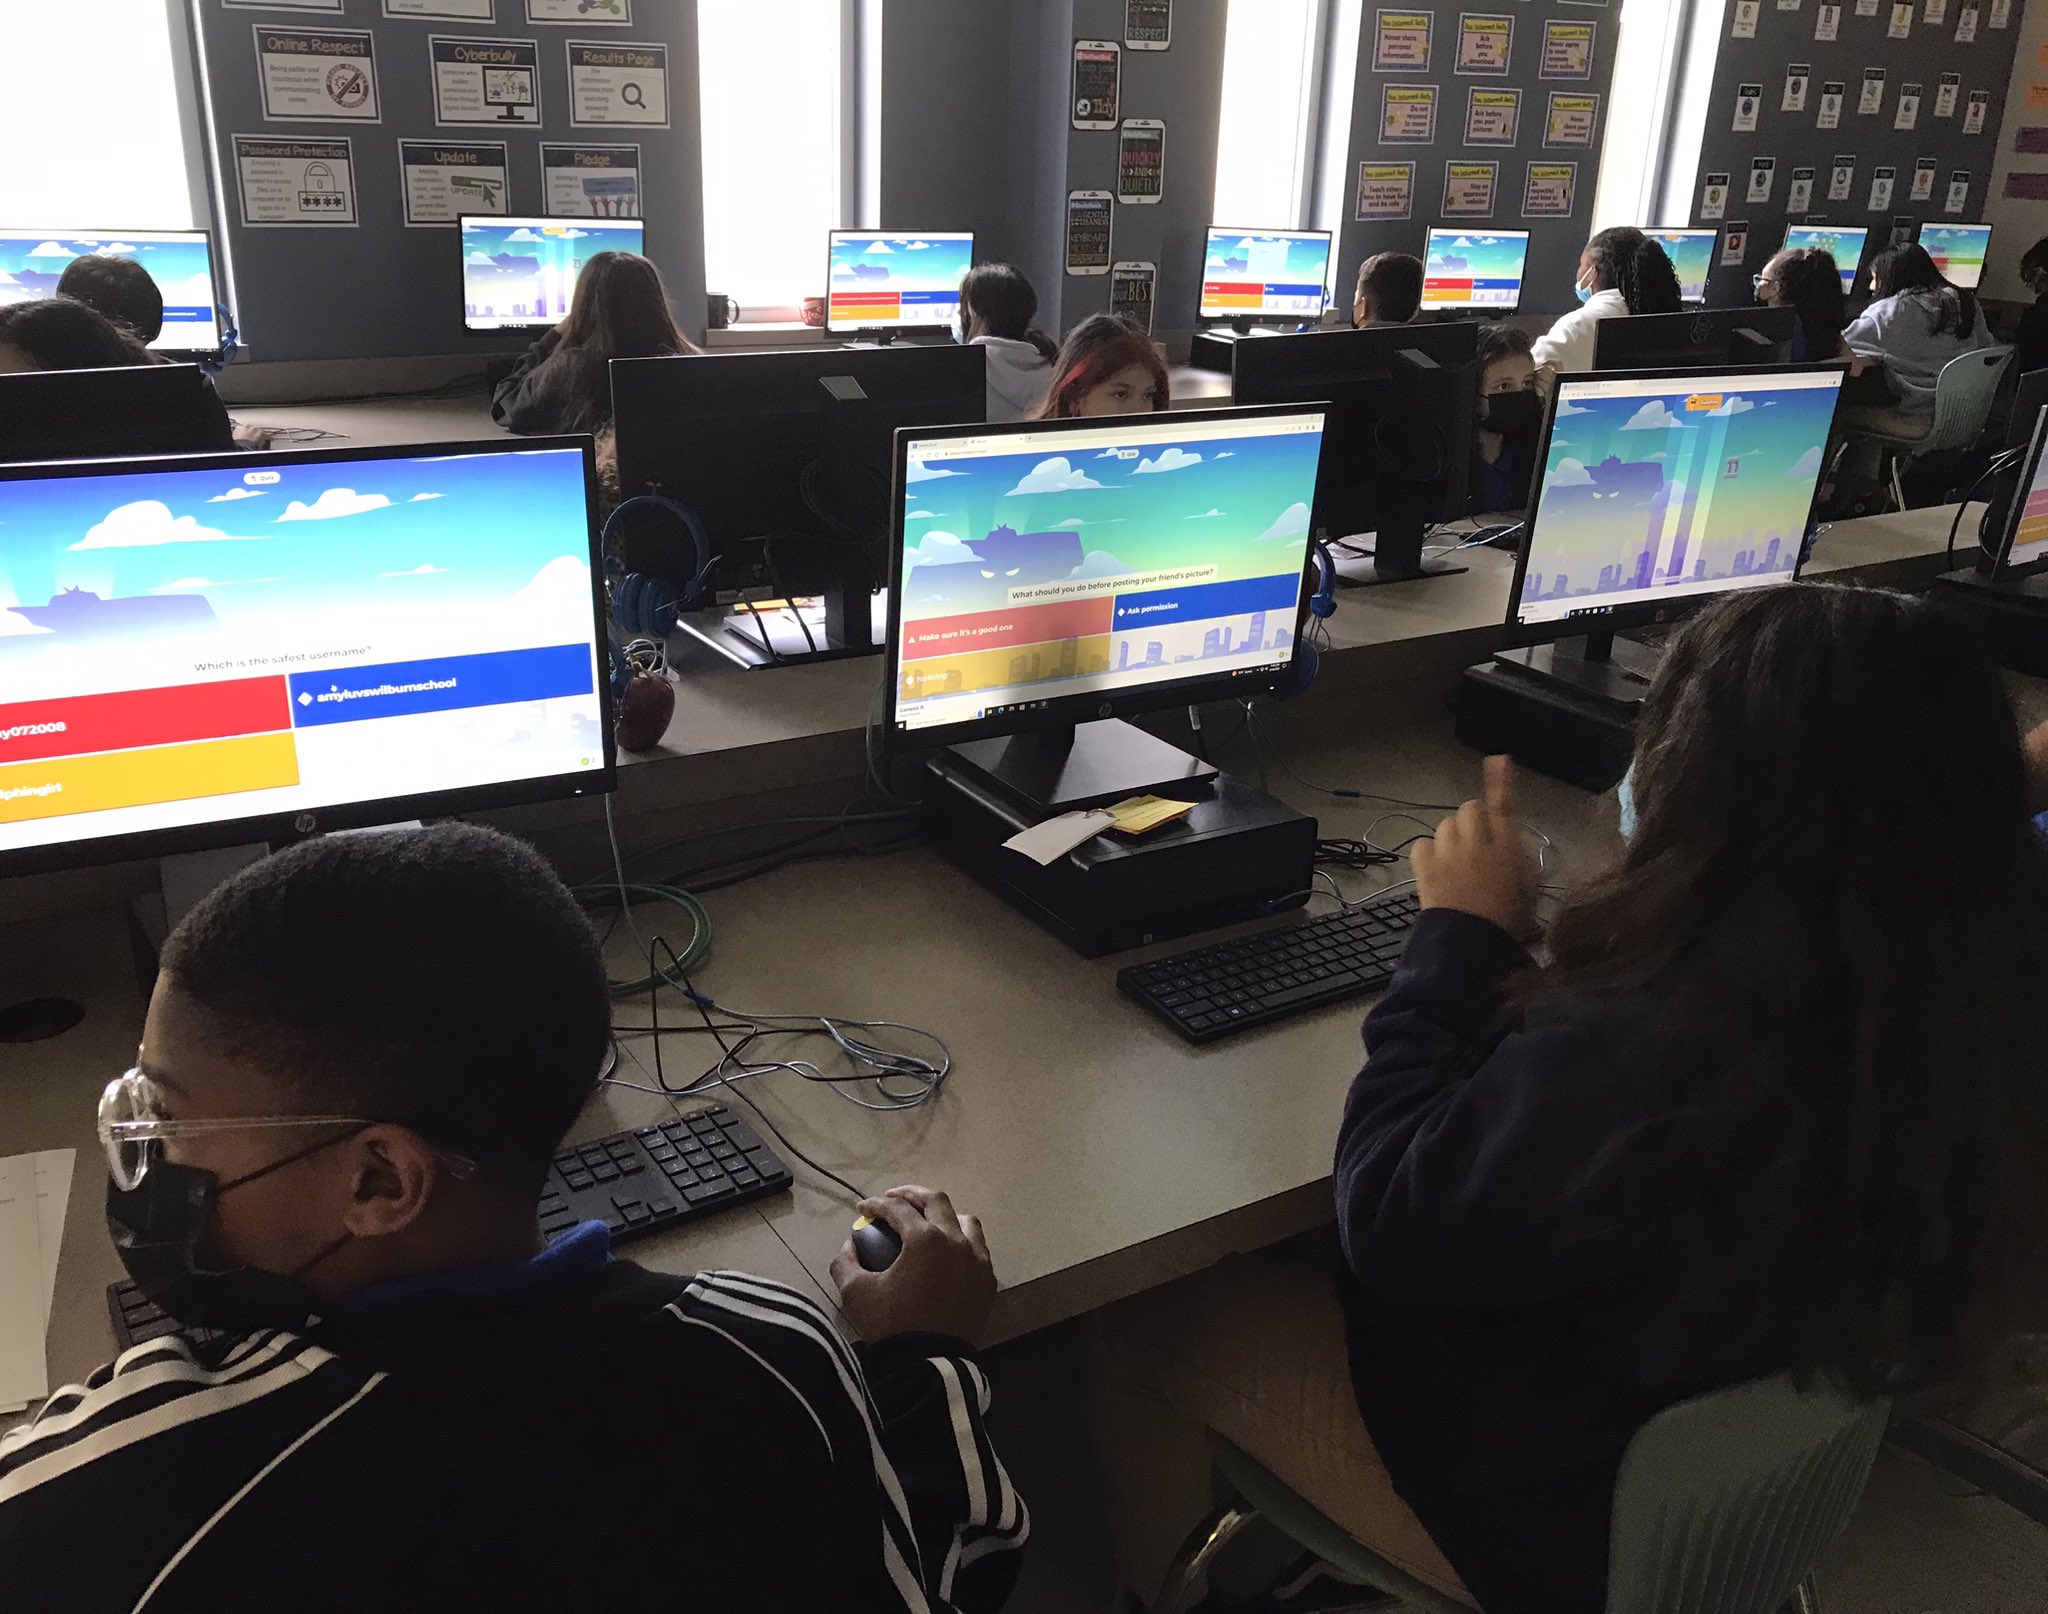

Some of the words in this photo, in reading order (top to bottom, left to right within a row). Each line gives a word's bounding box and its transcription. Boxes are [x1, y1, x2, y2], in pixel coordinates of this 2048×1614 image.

[1128, 27, 1167, 40] RESPECT
[267, 36, 308, 51] Online
[311, 38, 366, 55] Respect
[454, 47, 517, 64] Cyberbully
[582, 50, 624, 64] Results
[626, 52, 655, 68] Page
[1093, 98, 1115, 118] Tidy
[241, 144, 291, 156] Password
[292, 145, 347, 157] Protection
[434, 151, 478, 166] Update
[574, 152, 611, 168] Pledge
[1122, 152, 1160, 166] QUICKLY
[1134, 168, 1148, 176] AND
[451, 187, 483, 197] UPDATE
[1121, 178, 1160, 192] QUIETLY
[1082, 210, 1109, 218] GENTLE
[1071, 233, 1108, 242] KEYBOARD
[1129, 281, 1154, 301] BEST
[1012, 590, 1033, 600] What
[1034, 587, 1060, 597] should
[1061, 585, 1076, 596] you
[1076, 583, 1087, 592] do
[1088, 580, 1111, 590] before
[1112, 576, 1140, 589] posting
[1140, 574, 1158, 587] your
[1158, 572, 1185, 582] friend's
[1185, 568, 1214, 582] picture?
[1127, 606, 1140, 616] Ask
[1141, 602, 1178, 615] permission
[918, 634, 940, 642] Make
[941, 631, 958, 640] sure
[978, 626, 998, 636] good
[998, 624, 1014, 632] one
[194, 660, 233, 672] Which
[236, 658, 246, 668] is
[249, 656, 269, 666] the
[271, 652, 306, 664] safest
[309, 646, 372, 660] username?
[916, 673, 949, 683] Nothing
[294, 814, 316, 834] hp
